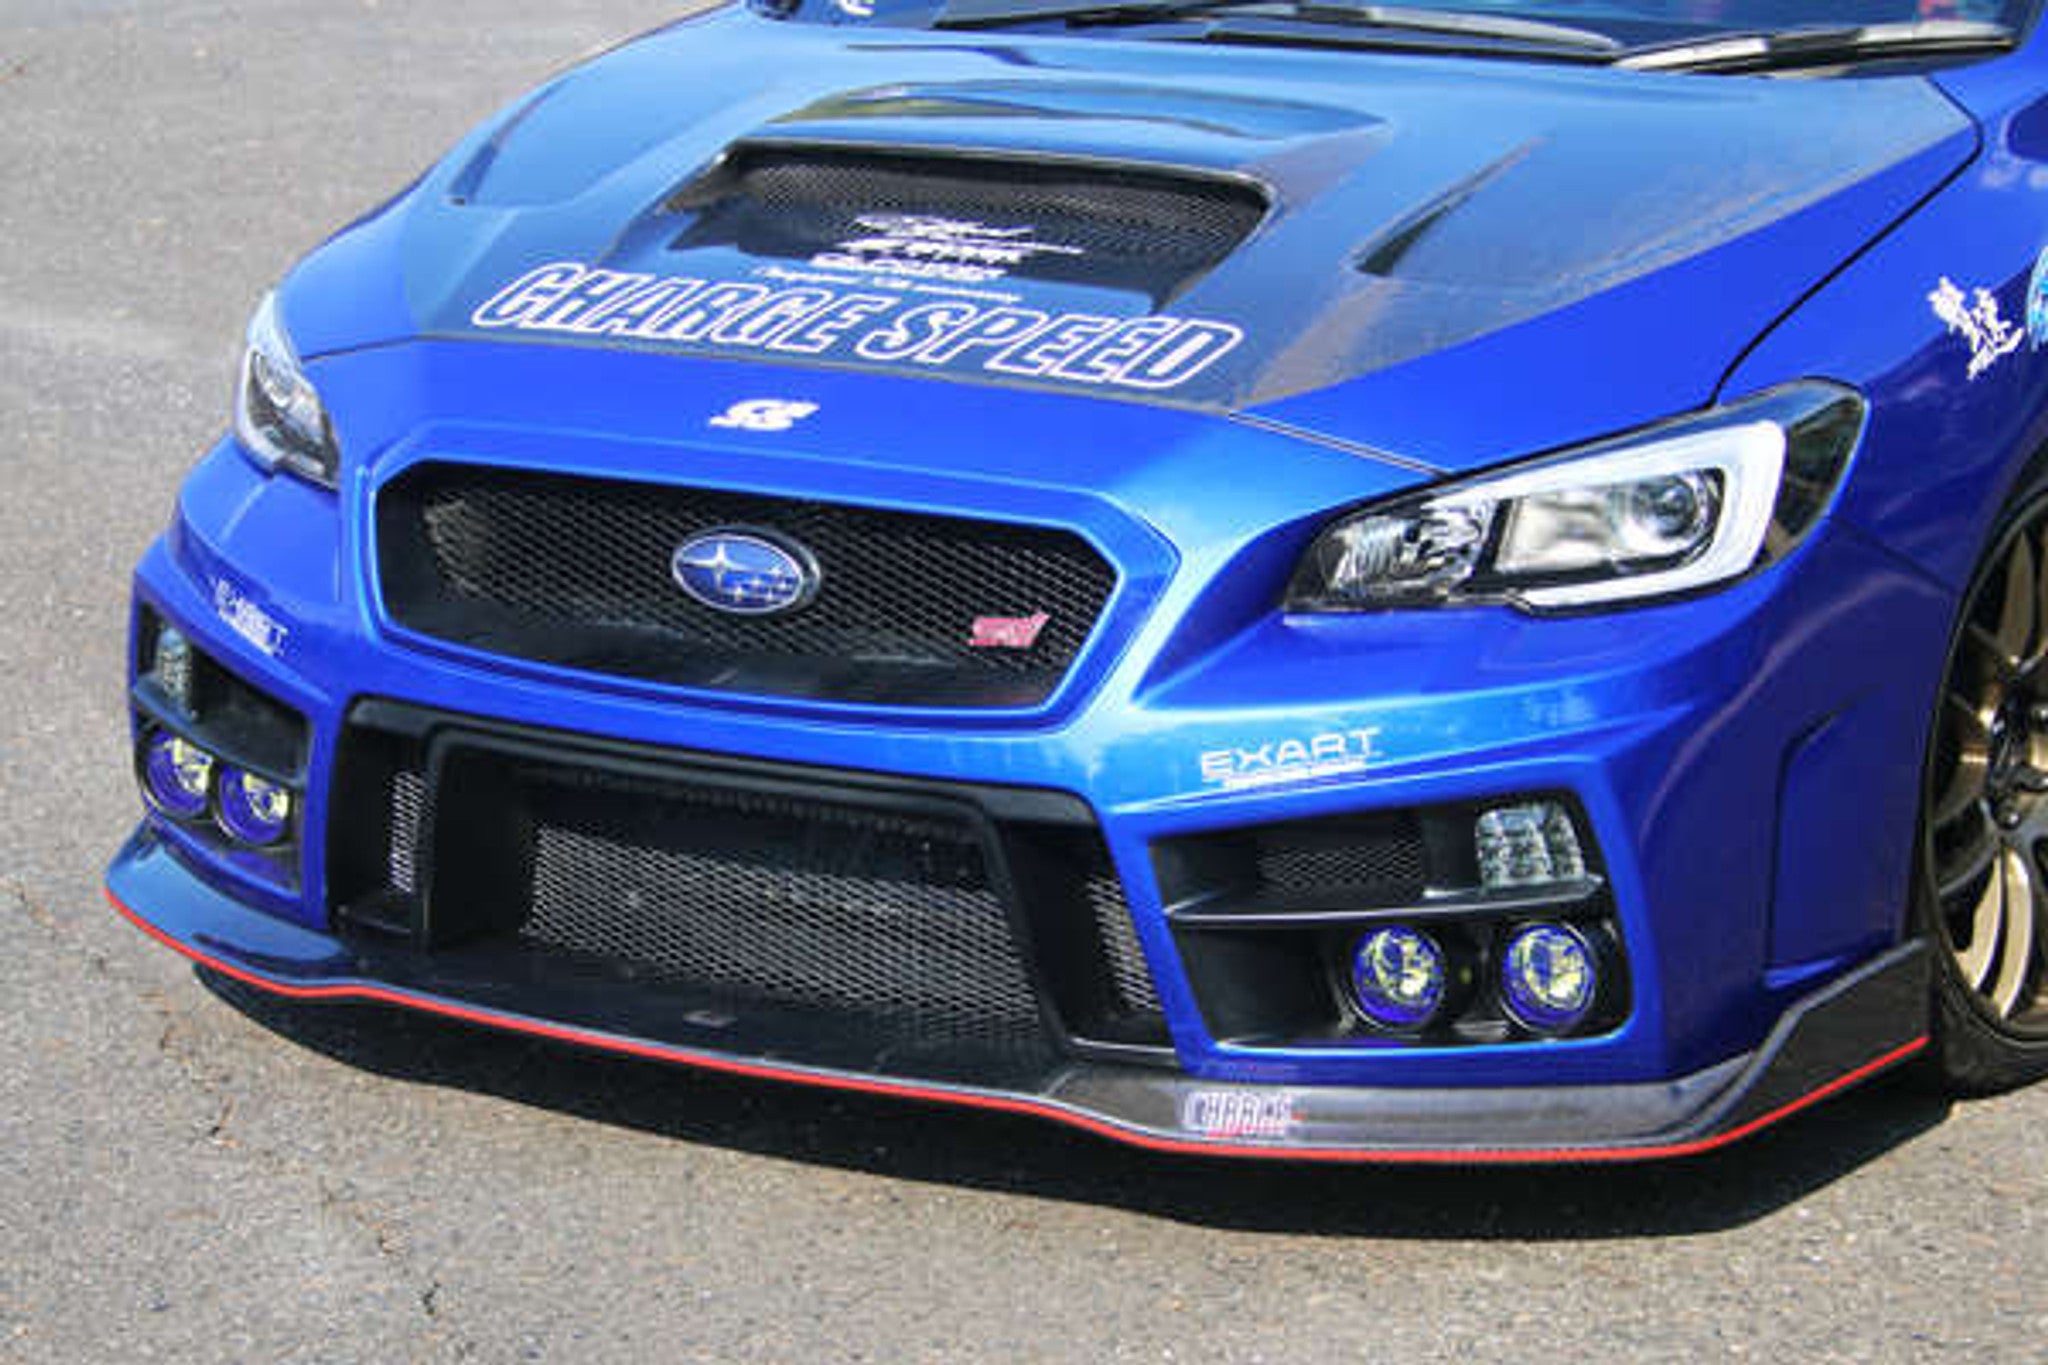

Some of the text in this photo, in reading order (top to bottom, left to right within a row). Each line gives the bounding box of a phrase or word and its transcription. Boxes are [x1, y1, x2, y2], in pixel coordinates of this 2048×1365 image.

[471, 262, 900, 353] CHARGE
[856, 302, 1243, 389] SPEED
[1201, 725, 1380, 777] EXART
